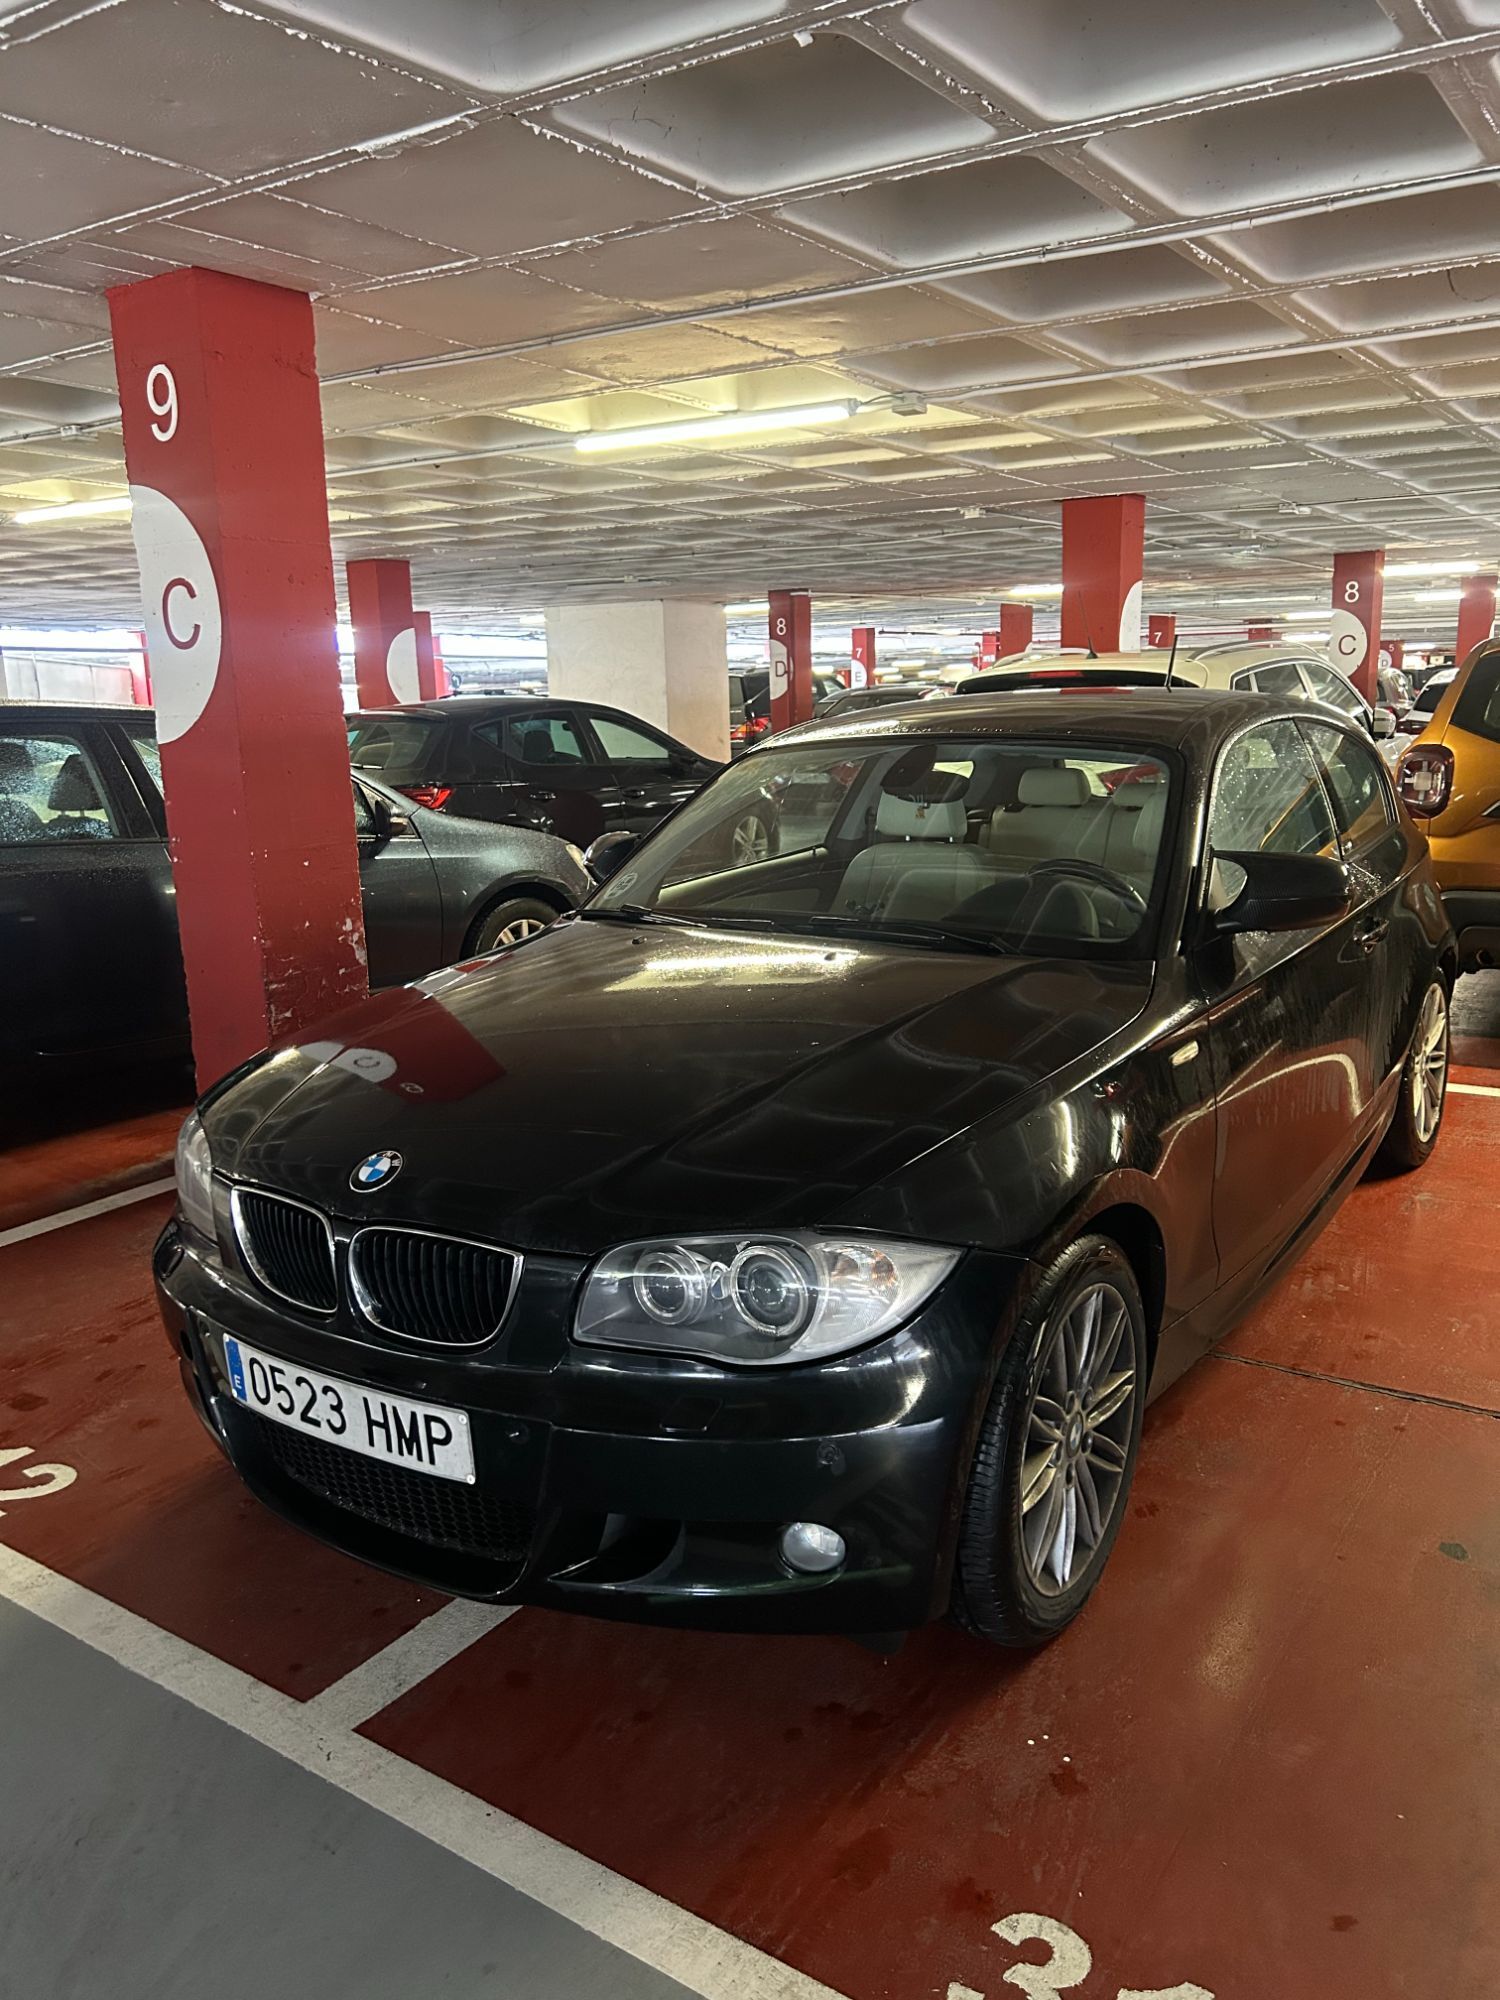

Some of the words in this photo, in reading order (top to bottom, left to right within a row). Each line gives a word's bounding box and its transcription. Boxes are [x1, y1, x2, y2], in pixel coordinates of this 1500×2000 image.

[146, 363, 179, 443] 9
[1344, 580, 1360, 603] 8
[162, 577, 202, 650] C
[776, 617, 787, 636] 8
[1153, 631, 1163, 644] 7
[1338, 634, 1357, 656] C
[855, 647, 863, 659] 7
[775, 660, 787, 678] D
[234, 1373, 242, 1390] E
[249, 1356, 347, 1436] 0523
[363, 1396, 453, 1466] HMP
